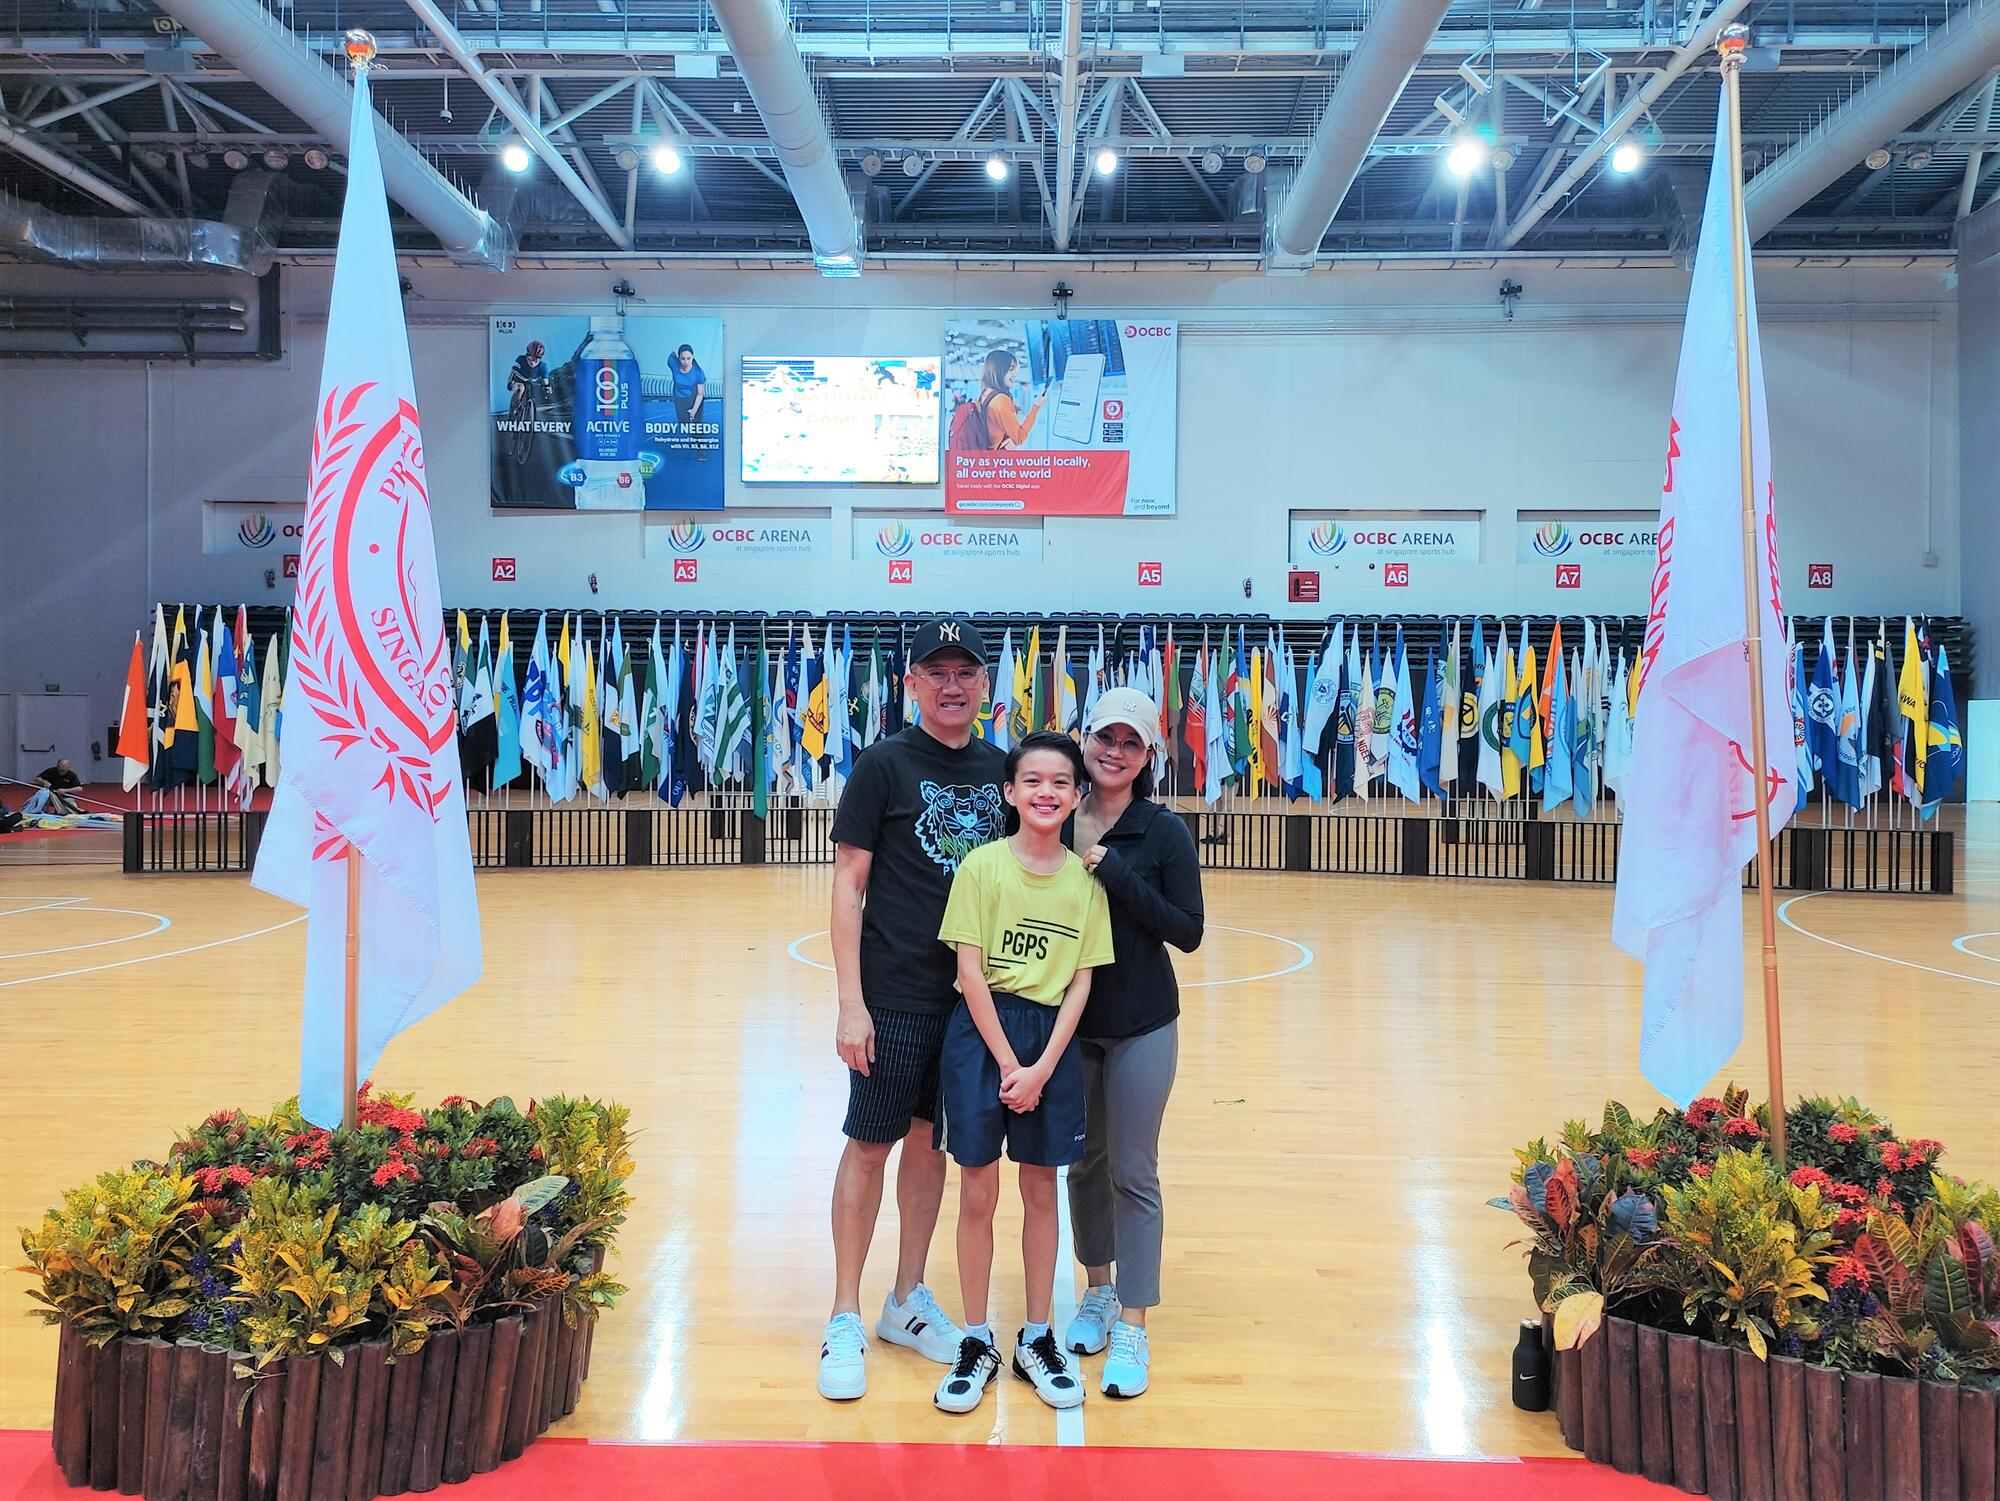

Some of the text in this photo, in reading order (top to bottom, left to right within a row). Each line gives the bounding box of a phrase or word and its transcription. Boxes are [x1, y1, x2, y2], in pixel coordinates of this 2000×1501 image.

[1138, 327, 1172, 337] OCBC
[620, 383, 629, 409] PLUS
[496, 421, 571, 433] WHAT EVERY
[585, 420, 630, 433] ACTIVE
[645, 423, 719, 434] BODY NEEDS
[956, 456, 1091, 468] Pay as you would locally,
[570, 473, 583, 482] B3
[956, 468, 1051, 478] all over the world
[619, 476, 630, 484] B6
[712, 530, 811, 542] OCBC ARENA
[920, 533, 1019, 546] OCBC ARENA
[1353, 532, 1455, 545] OCBC ARENA
[1579, 533, 1624, 545] OCBC
[743, 545, 776, 554] singapore
[776, 545, 798, 553] sports
[798, 544, 812, 552] hub
[951, 549, 983, 558] singapore
[984, 549, 1005, 557] sports
[1385, 548, 1418, 556] singapore
[1419, 548, 1441, 556] sports
[1612, 549, 1645, 557] singapore
[494, 565, 515, 578] A2
[675, 566, 697, 580] A3
[890, 568, 911, 581] A4
[1139, 569, 1161, 583] A5
[1386, 570, 1408, 583] A6
[1557, 572, 1579, 585] A7
[1810, 571, 1832, 585] A8
[939, 621, 961, 642] NY
[1001, 929, 1049, 961] PGPS
